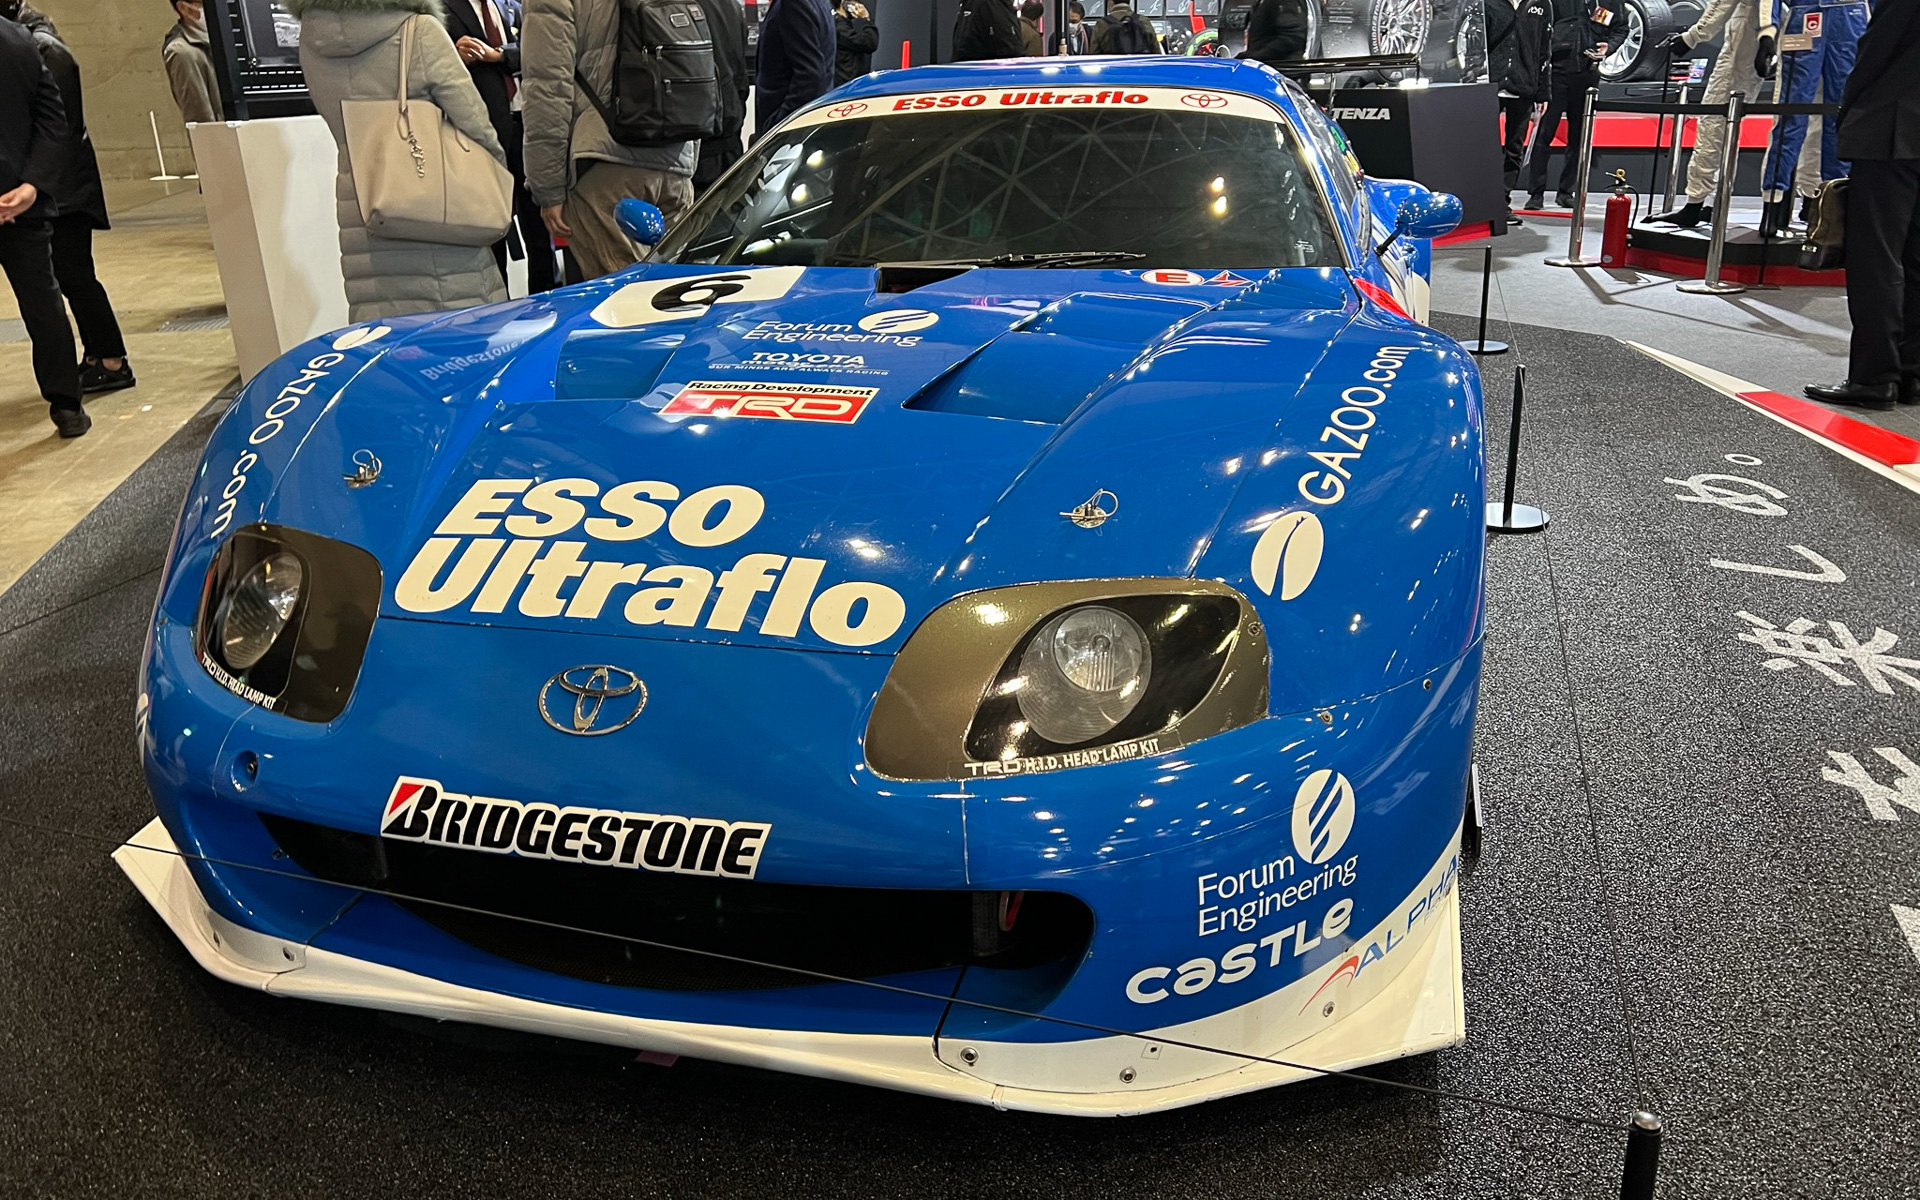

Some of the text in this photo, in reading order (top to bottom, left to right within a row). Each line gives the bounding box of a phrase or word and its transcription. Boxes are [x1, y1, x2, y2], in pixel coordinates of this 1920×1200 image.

[892, 90, 1149, 112] ESSO Ultraflo
[1332, 108, 1391, 120] TENZA
[651, 274, 752, 313] 6
[742, 330, 924, 347] Engineering
[755, 321, 853, 332] Forum
[752, 351, 865, 365] TOYOTA
[684, 394, 853, 418] TRD
[690, 382, 873, 396] Racing Development
[1298, 346, 1412, 505] GAZOO.com
[210, 352, 345, 539] GAZOO.com
[434, 477, 765, 547] ESSO
[395, 537, 906, 647] Ultraflo
[964, 758, 1021, 776] TRD
[1063, 750, 1101, 768] HEAD
[1102, 743, 1138, 762] LAMP
[1138, 738, 1160, 755] KIT
[382, 782, 765, 875] BRIDGESTONE
[1198, 855, 1294, 905] Forum
[1199, 855, 1359, 937] Engineering
